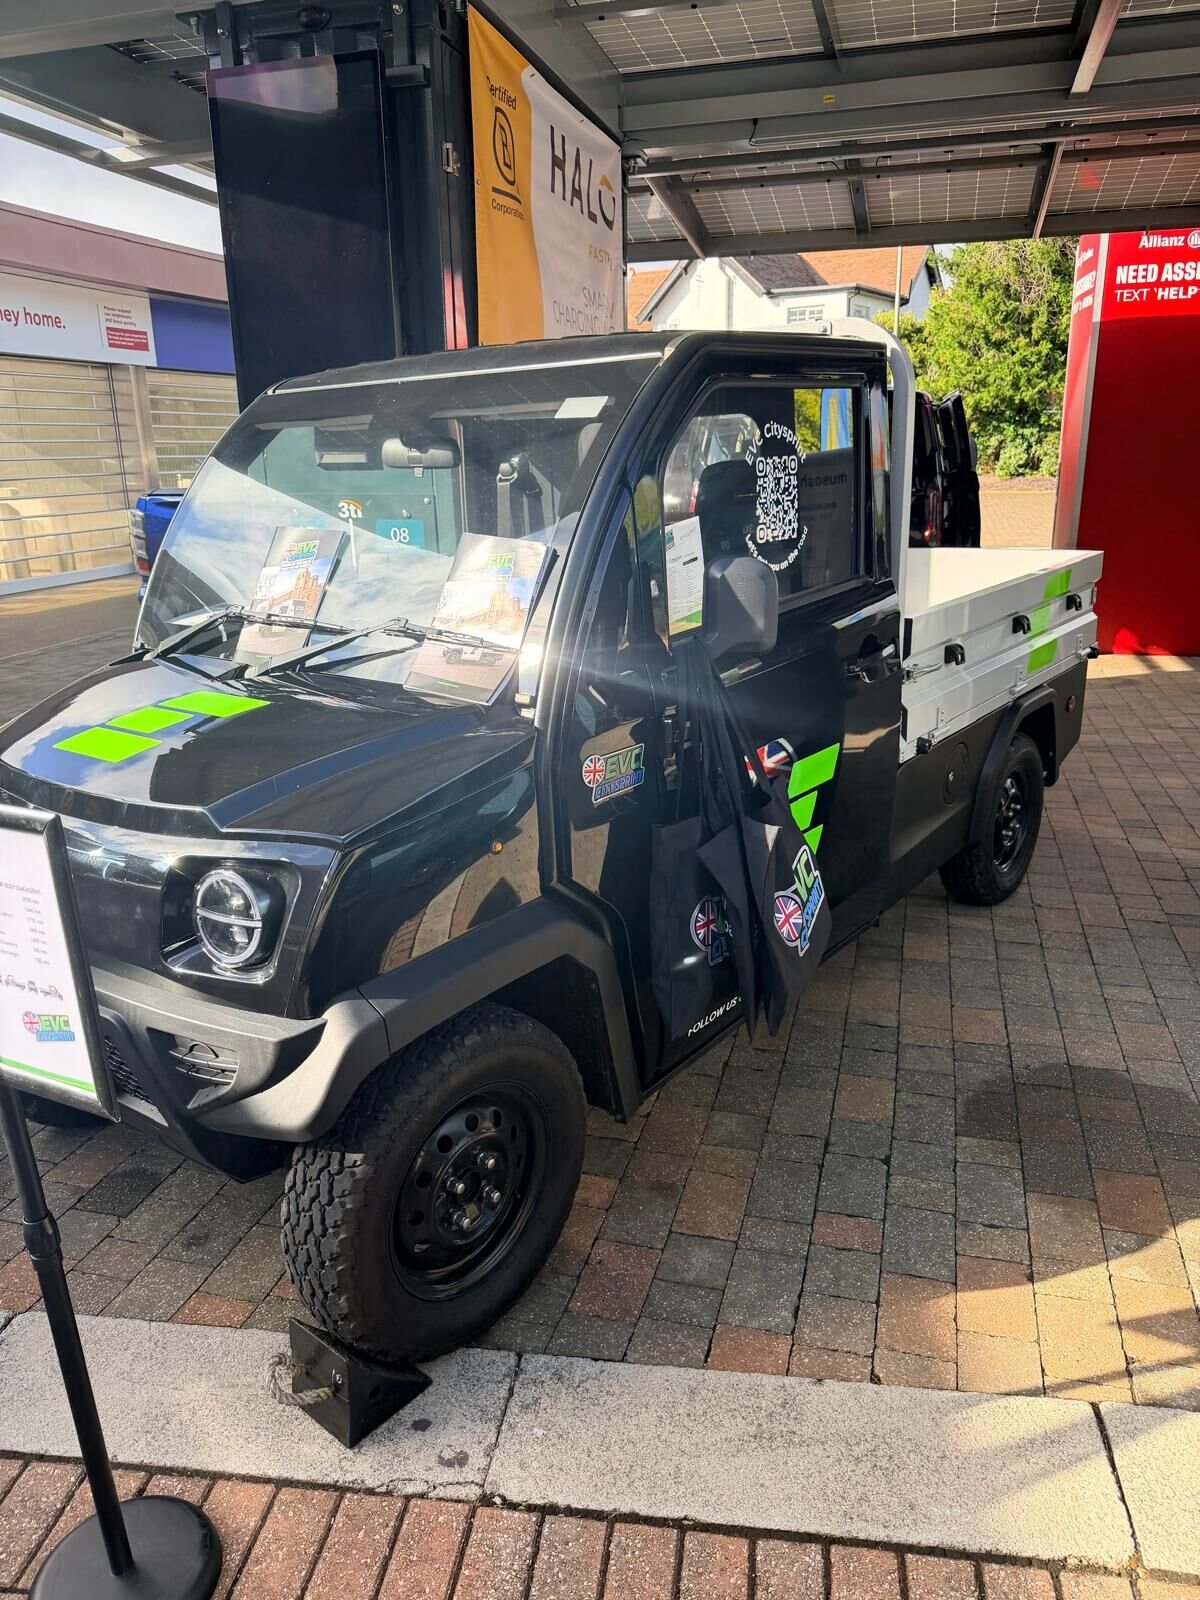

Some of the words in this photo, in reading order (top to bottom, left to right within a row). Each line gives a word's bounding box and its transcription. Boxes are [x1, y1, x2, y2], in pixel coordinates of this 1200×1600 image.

[491, 198, 524, 220] Corporation
[1139, 235, 1185, 249] Allianz
[1116, 264, 1159, 284] NEED
[1114, 288, 1151, 303] TEXT
[23, 306, 66, 329] home.
[745, 430, 764, 466] EVC
[764, 420, 808, 464] Citysprint
[390, 527, 410, 543] 08
[780, 560, 789, 570] on
[787, 549, 799, 564] the
[797, 525, 808, 550] road
[604, 747, 643, 780] EVC
[594, 769, 644, 799] CITYSPRINT
[40, 1014, 70, 1032] EVC
[687, 1004, 726, 1037] FOLLOW
[726, 996, 738, 1011] US
